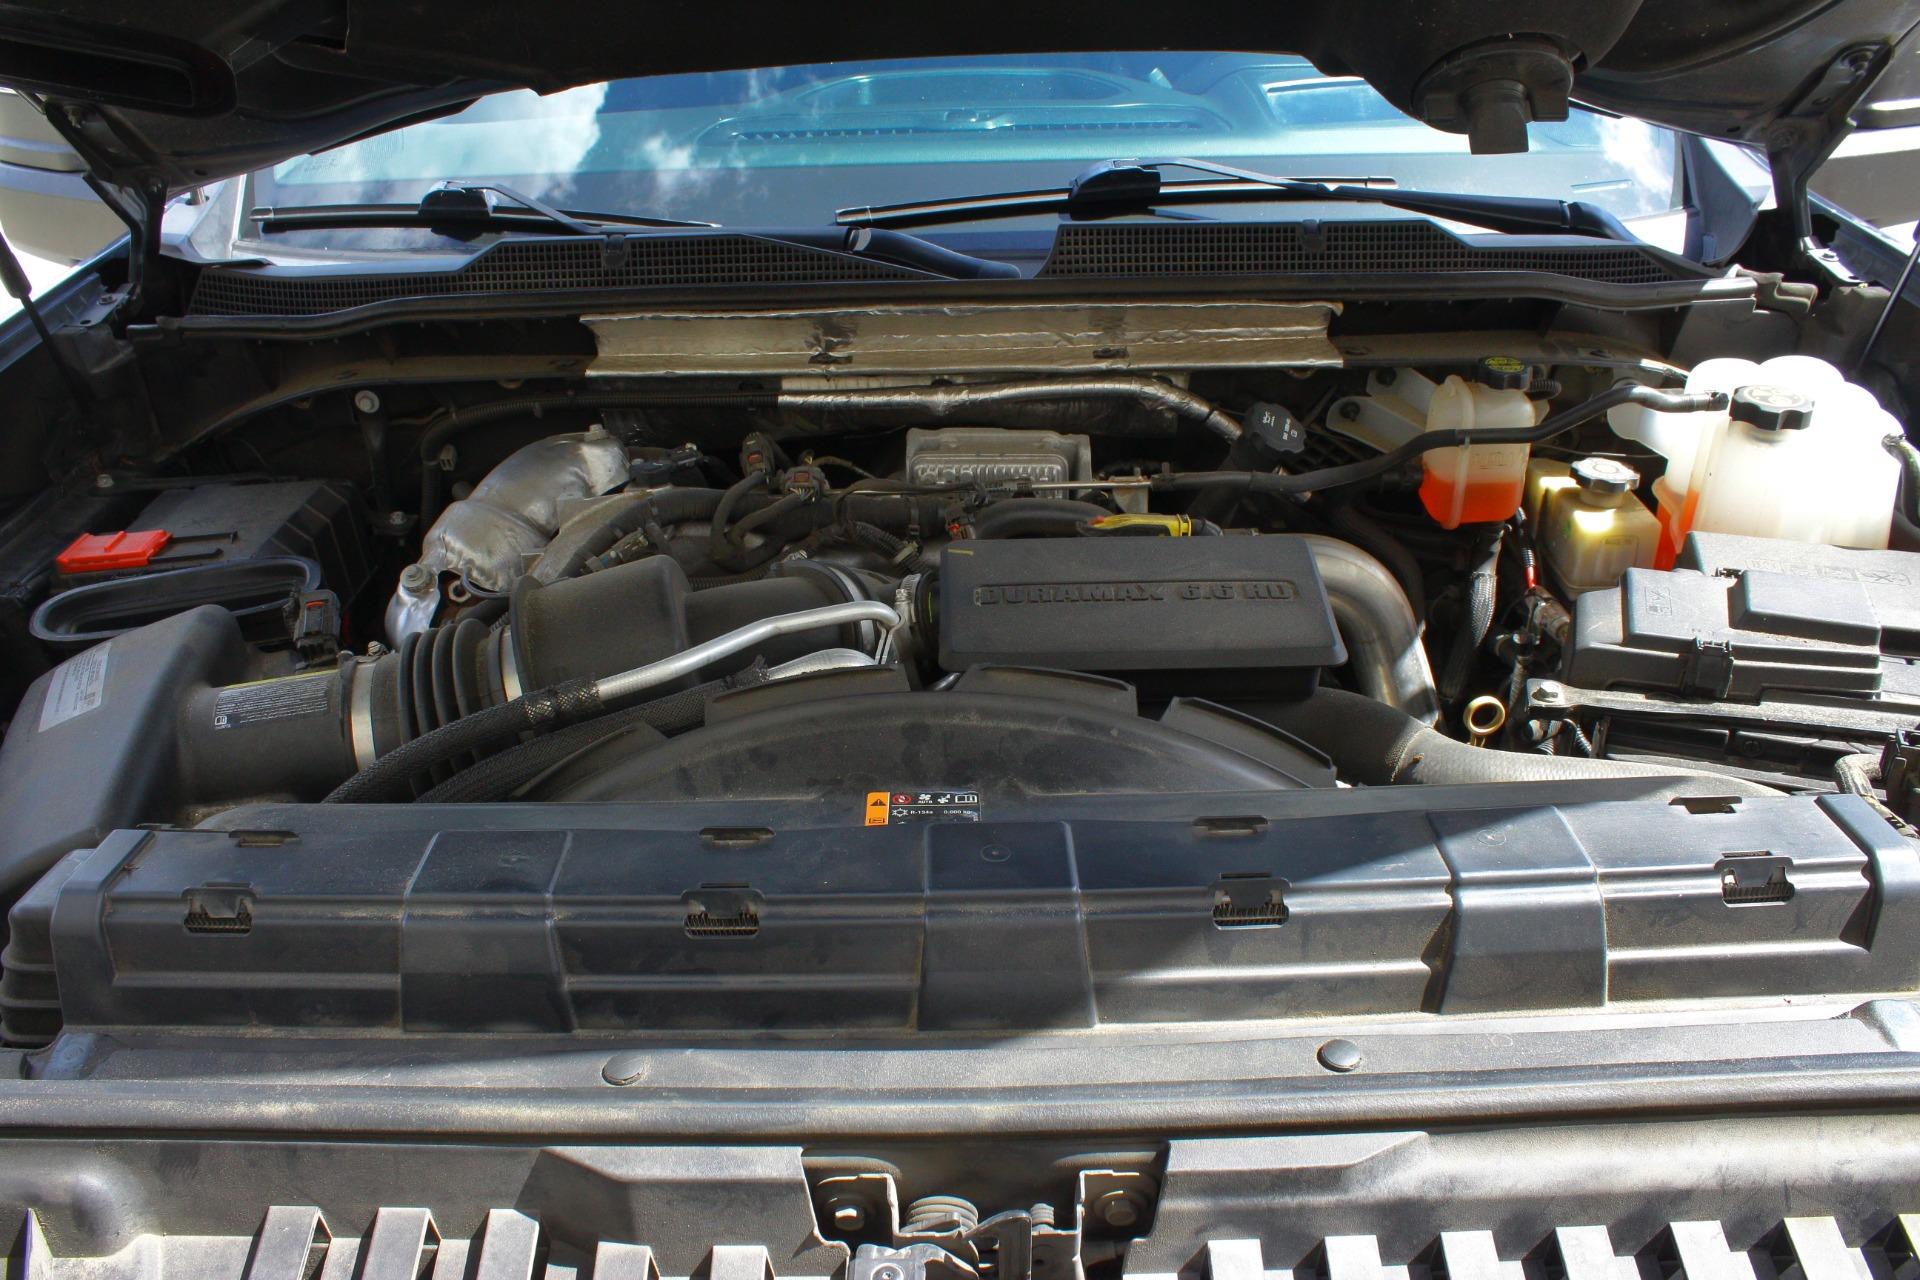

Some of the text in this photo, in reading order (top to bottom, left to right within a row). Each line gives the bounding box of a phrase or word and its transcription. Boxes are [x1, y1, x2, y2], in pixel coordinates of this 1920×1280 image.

[979, 582, 1293, 605] DURAMAX 6.6 HD
